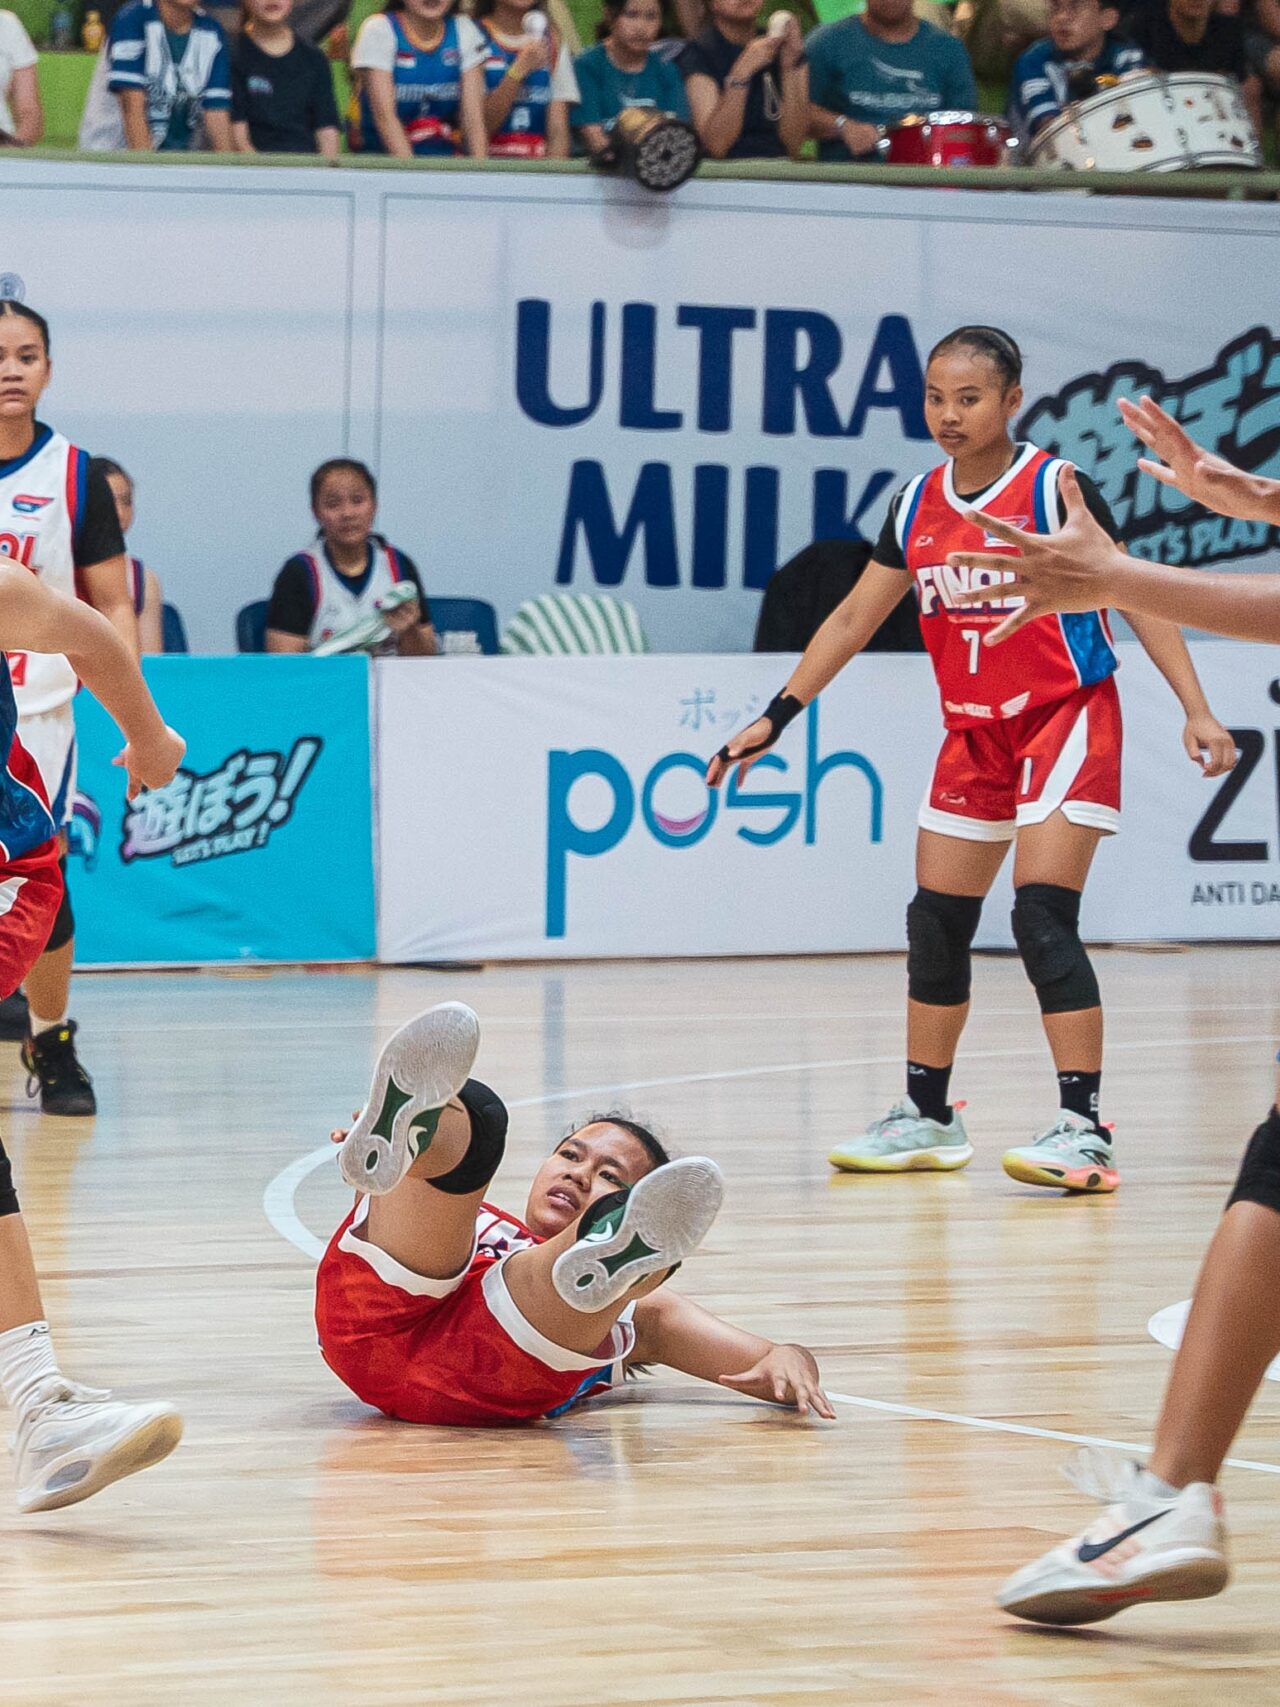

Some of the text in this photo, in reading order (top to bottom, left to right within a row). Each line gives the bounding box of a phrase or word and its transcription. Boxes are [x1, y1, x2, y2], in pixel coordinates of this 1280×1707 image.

[516, 299, 936, 439] ULTRA
[555, 459, 896, 591] MILK
[545, 693, 884, 938] posh
[1191, 881, 1246, 906] ANTI
